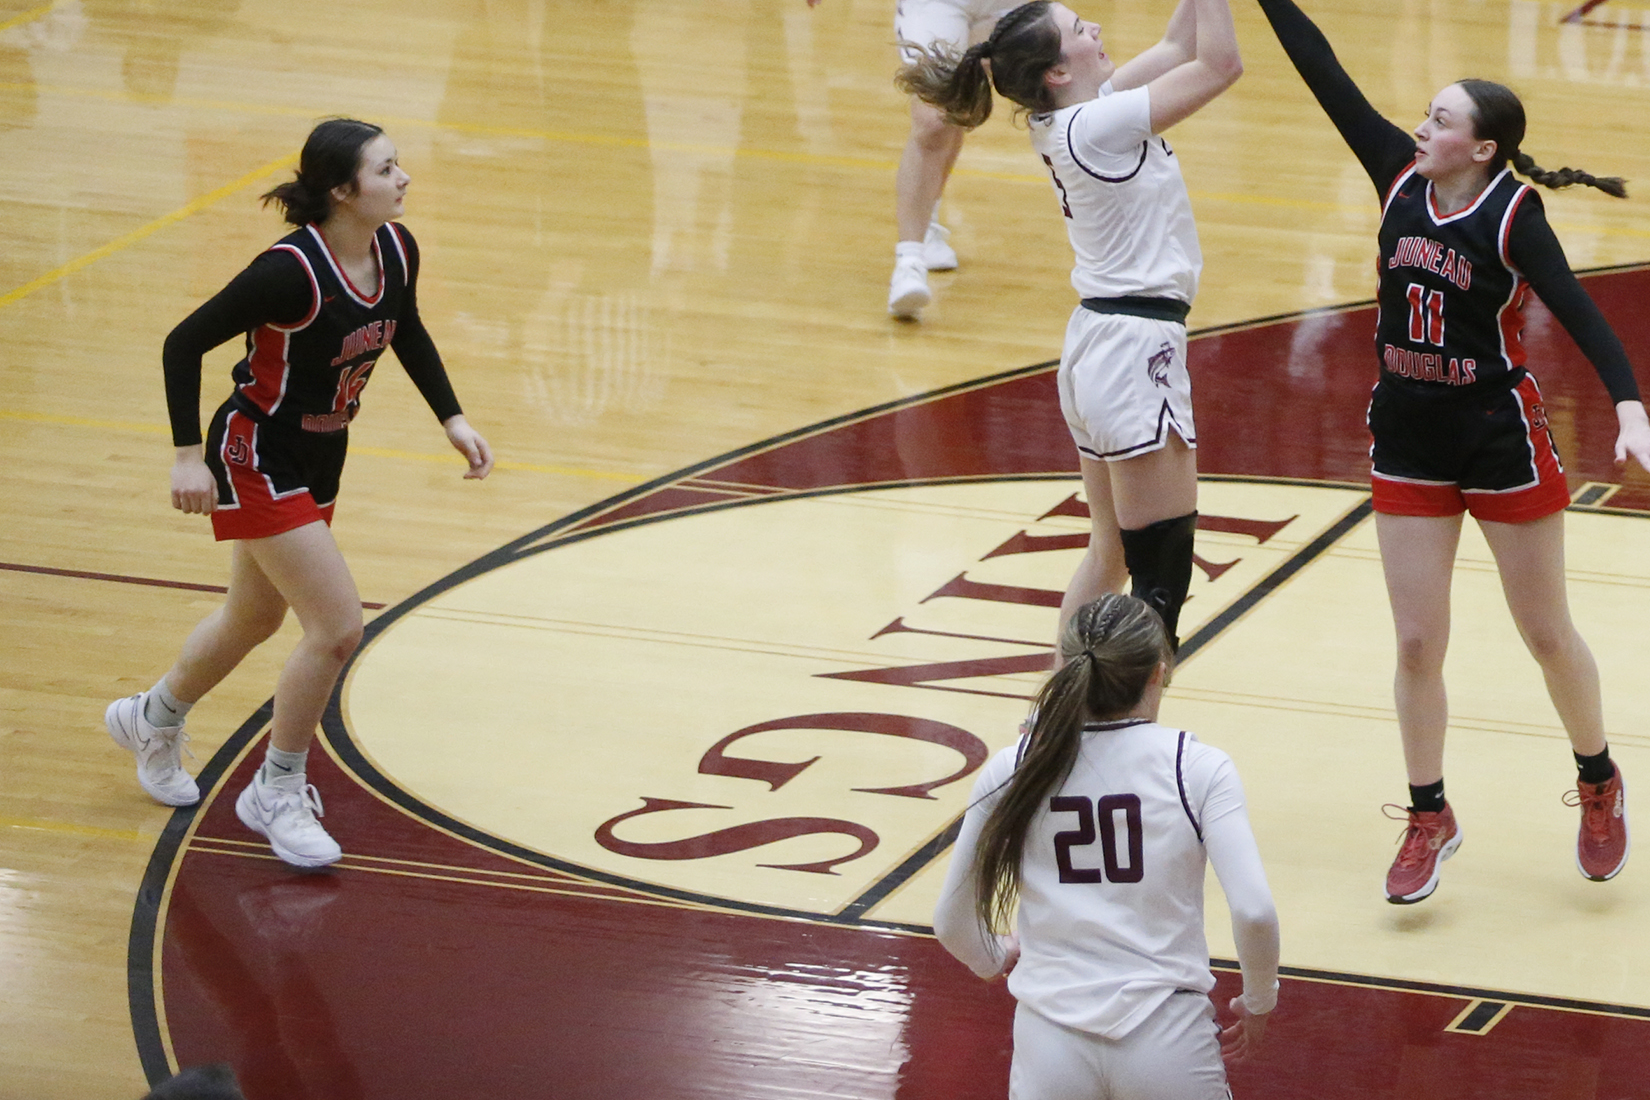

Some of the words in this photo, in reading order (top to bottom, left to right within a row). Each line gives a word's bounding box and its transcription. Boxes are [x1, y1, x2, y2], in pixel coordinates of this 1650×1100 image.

[1388, 236, 1473, 291] JUNEAU
[1406, 282, 1446, 348] 11
[1384, 343, 1477, 387] DOUGLAS
[1049, 792, 1145, 885] 20
